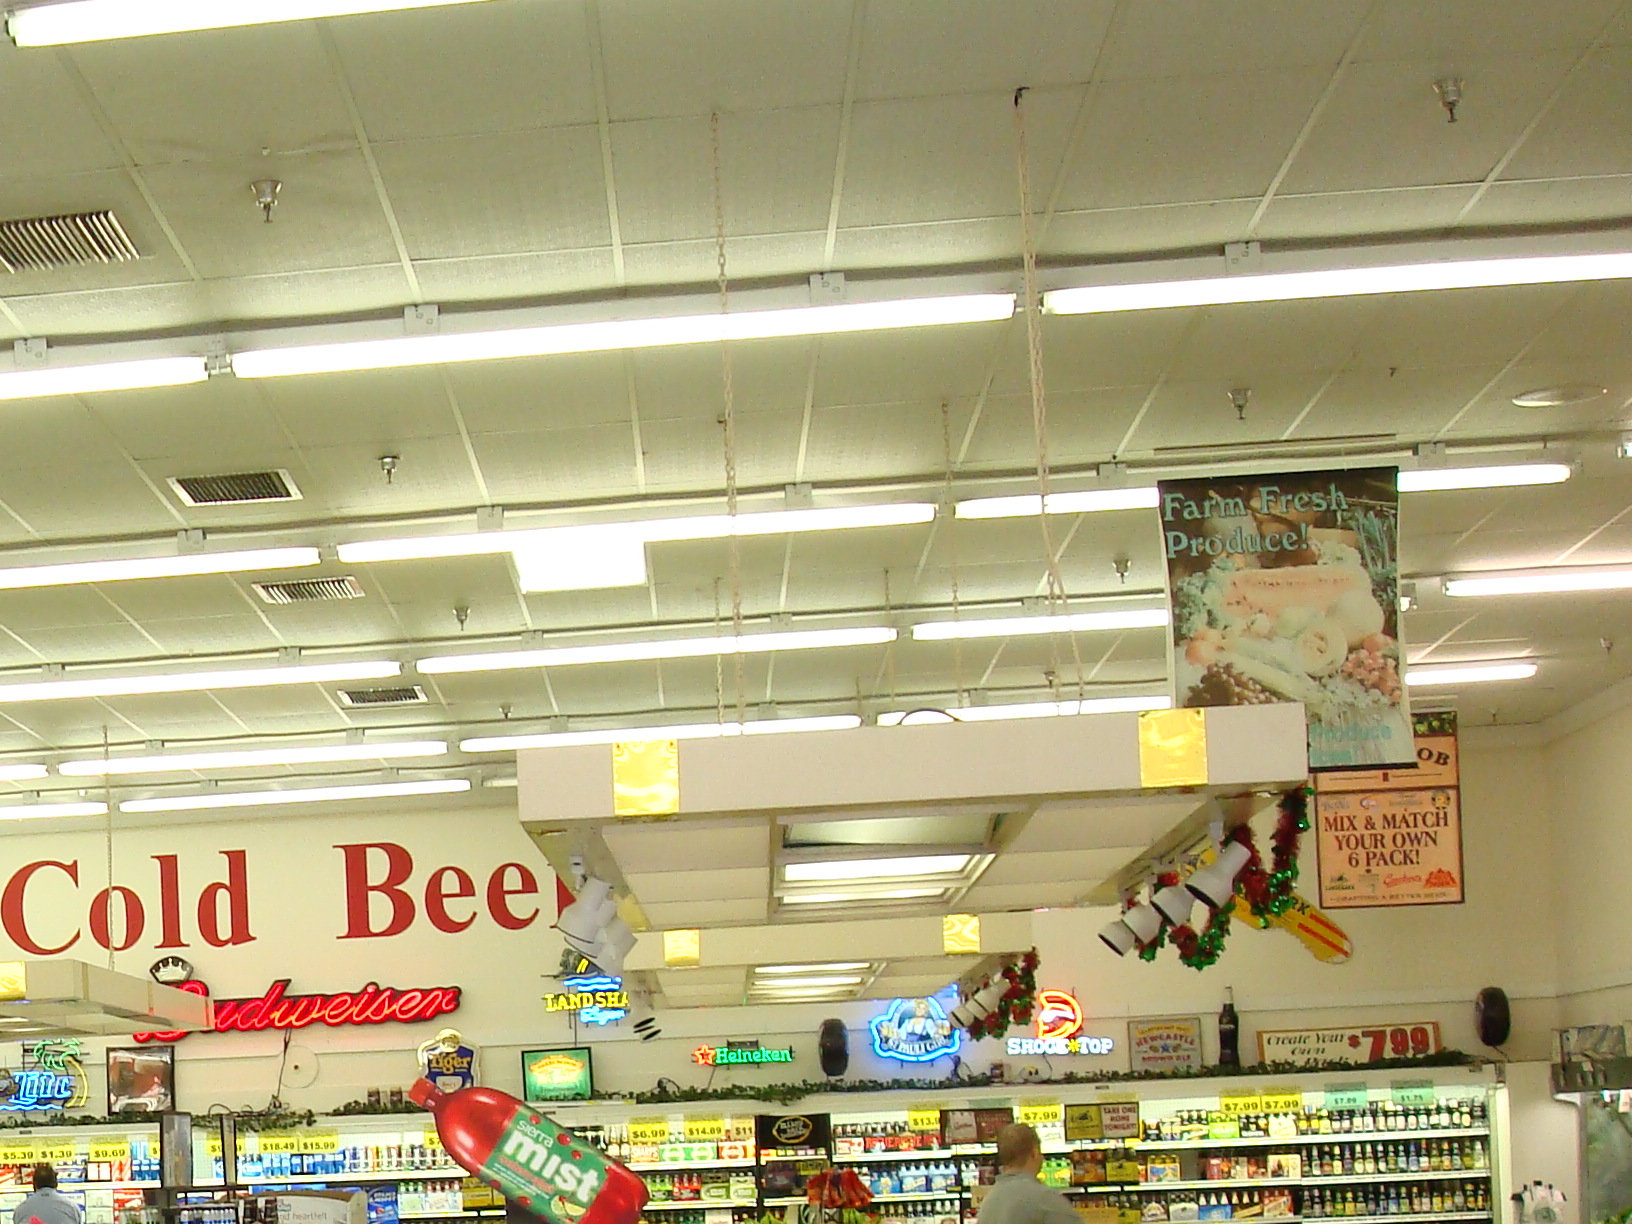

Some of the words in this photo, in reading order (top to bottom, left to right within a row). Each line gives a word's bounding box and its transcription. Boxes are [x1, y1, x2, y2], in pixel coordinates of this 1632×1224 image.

[1163, 492, 1246, 522] Farm
[1259, 482, 1348, 514] Fresh
[1166, 522, 1309, 559] Produce!
[1324, 815, 1358, 832] MIX
[1364, 814, 1376, 830] &
[1382, 811, 1449, 830] MATCH
[1334, 833, 1386, 851] YOUR
[1392, 831, 1438, 849] OWN
[1348, 852, 1359, 868] 6
[1366, 850, 1420, 867] PACK!
[0, 848, 257, 957] Cold
[1079, 1037, 1114, 1055] TOP
[1136, 1034, 1196, 1047] NEWCASTLE
[1267, 1033, 1311, 1047] Create
[1316, 1032, 1345, 1046] Your
[430, 1053, 471, 1074] Tiger
[715, 1044, 793, 1065] Heineken
[1224, 1101, 1258, 1111] $7.99
[1265, 1100, 1299, 1110] $7.99
[1023, 1111, 1058, 1121] $7.99
[517, 1120, 554, 1148] sierra
[632, 1129, 666, 1140] $6.99
[504, 1129, 599, 1202] mist
